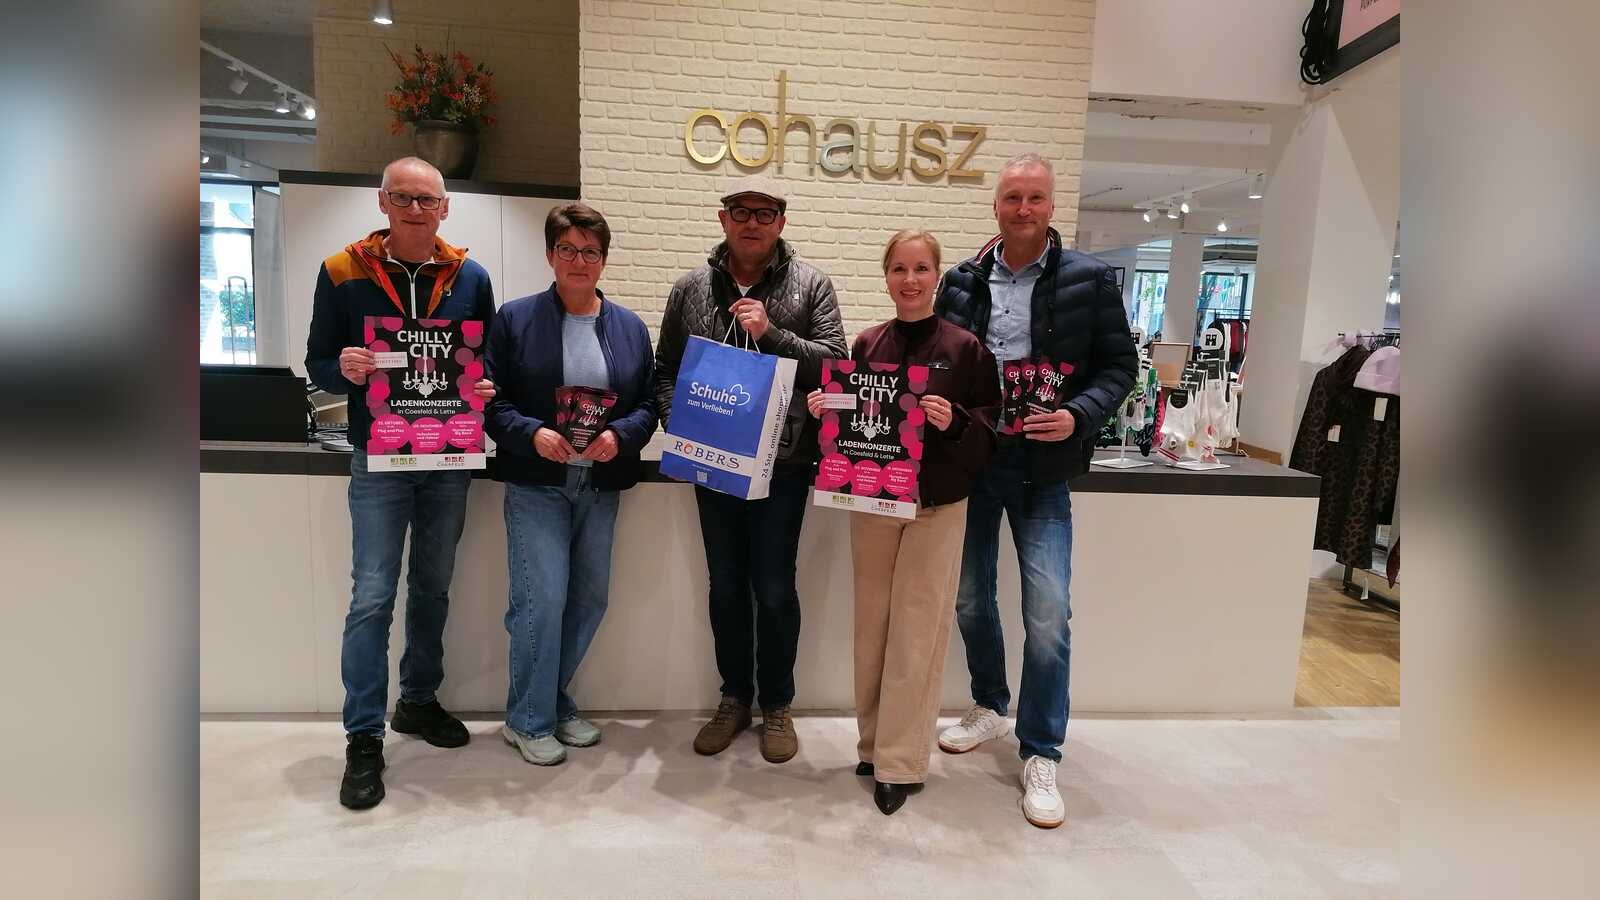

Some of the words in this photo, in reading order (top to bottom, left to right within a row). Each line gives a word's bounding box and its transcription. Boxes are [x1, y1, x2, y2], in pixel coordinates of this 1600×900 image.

[684, 70, 987, 179] cohausz
[397, 330, 452, 344] CHILLY
[409, 343, 453, 359] CITY
[849, 373, 899, 389] CHILLY
[1041, 368, 1065, 381] CHILLY
[1044, 375, 1063, 387] CITY
[689, 381, 737, 406] Schuhe
[859, 386, 898, 403] CITY
[390, 399, 462, 407] LADENKONZERTE
[687, 399, 701, 408] zum
[701, 401, 734, 417] Verlieben!
[770, 423, 780, 449] online
[838, 439, 902, 454] LADENKONZERTE
[849, 450, 873, 458] Coesfeld
